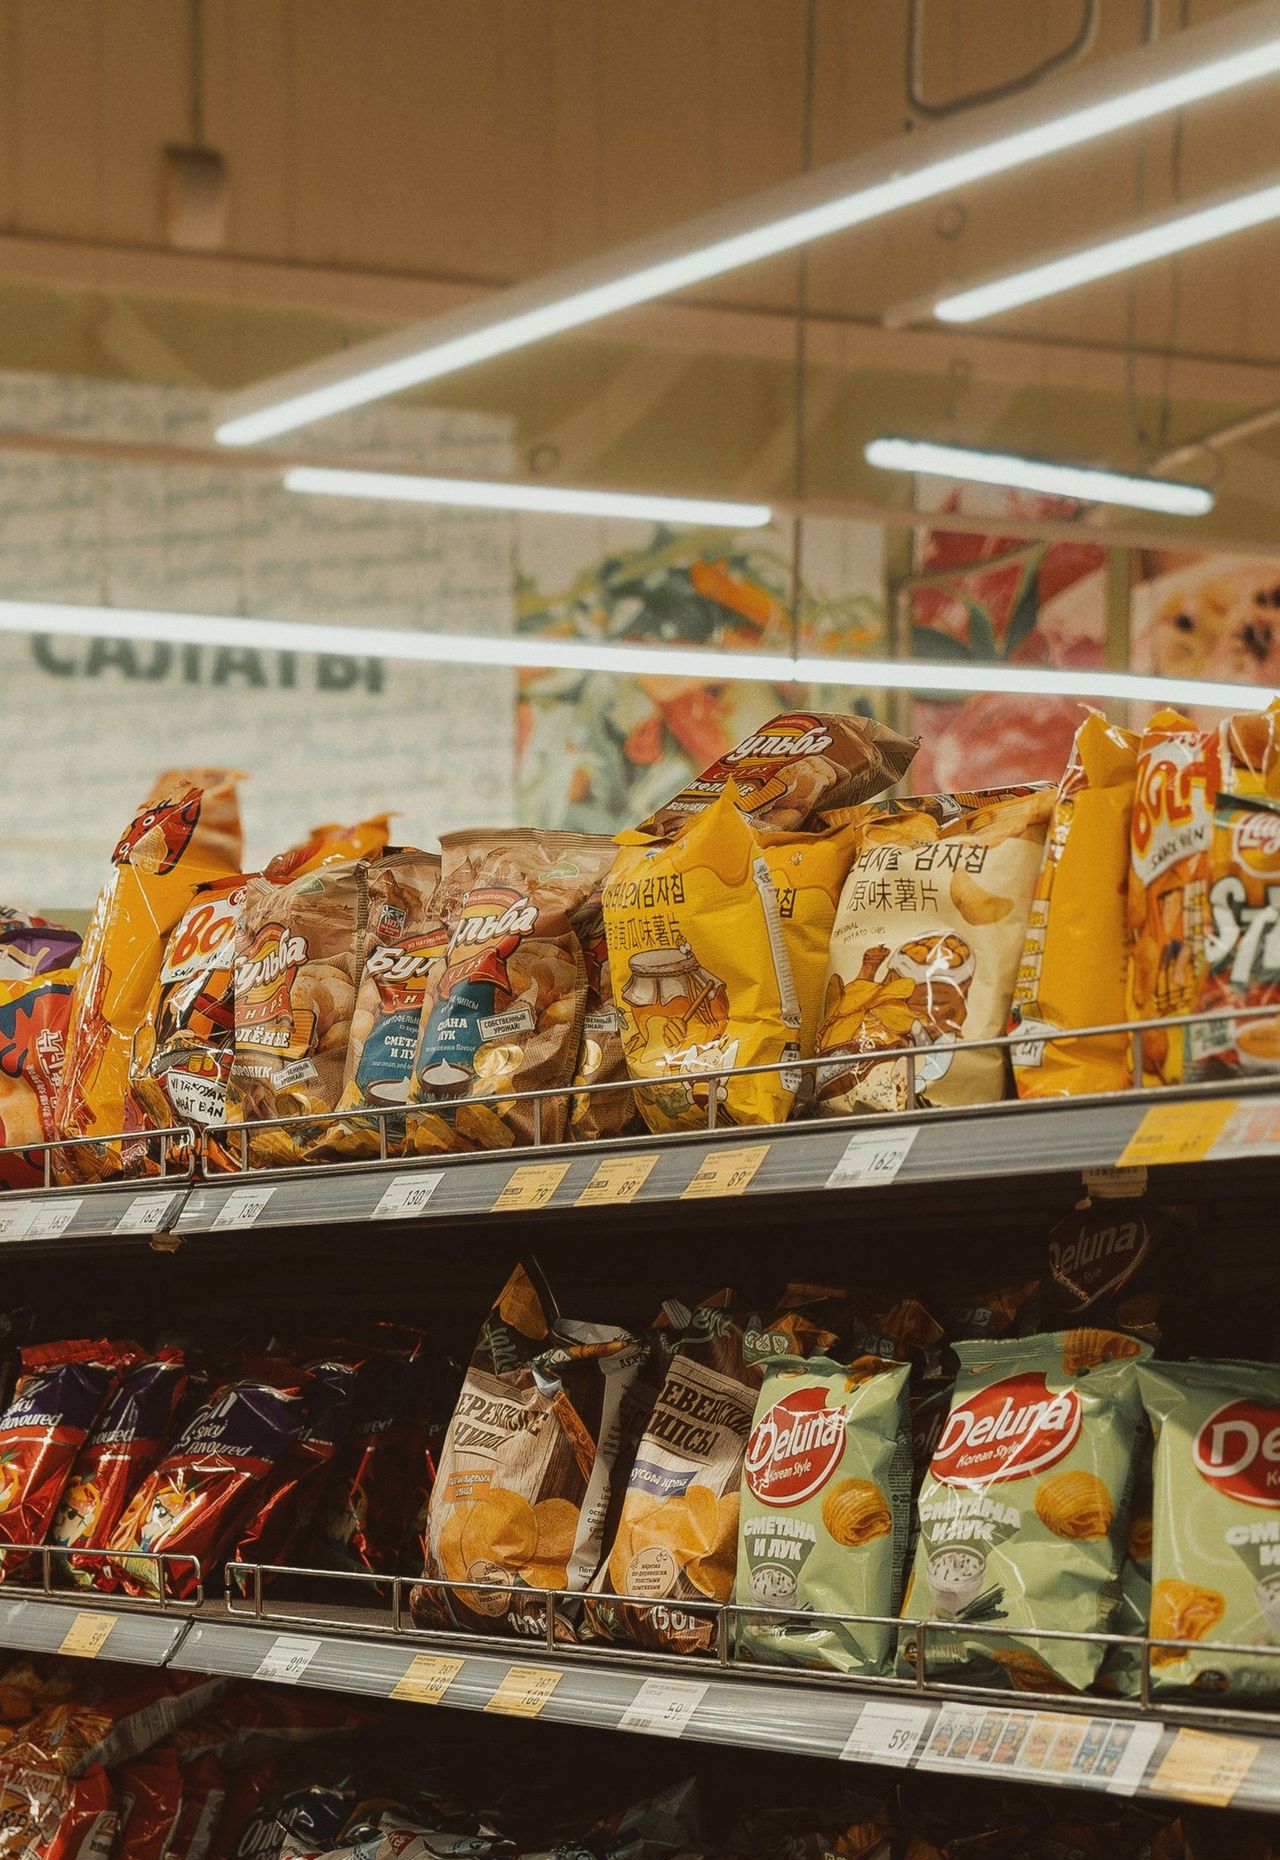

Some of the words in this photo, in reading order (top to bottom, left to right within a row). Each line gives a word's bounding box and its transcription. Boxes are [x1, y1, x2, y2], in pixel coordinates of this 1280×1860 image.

[726, 727, 835, 762] ульба
[846, 877, 939, 913] 原味薯片
[384, 1035, 418, 1048] СМЕТА
[401, 1048, 416, 1060] ЛУ
[646, 1408, 721, 1457] ИПСЫ
[746, 1405, 846, 1472] Deluna
[931, 1396, 1073, 1462] Deluna
[955, 1449, 994, 1469] Korean
[742, 1516, 817, 1543] СМЕТАНА
[753, 1537, 765, 1555] И
[767, 1539, 802, 1562] ЛУК
